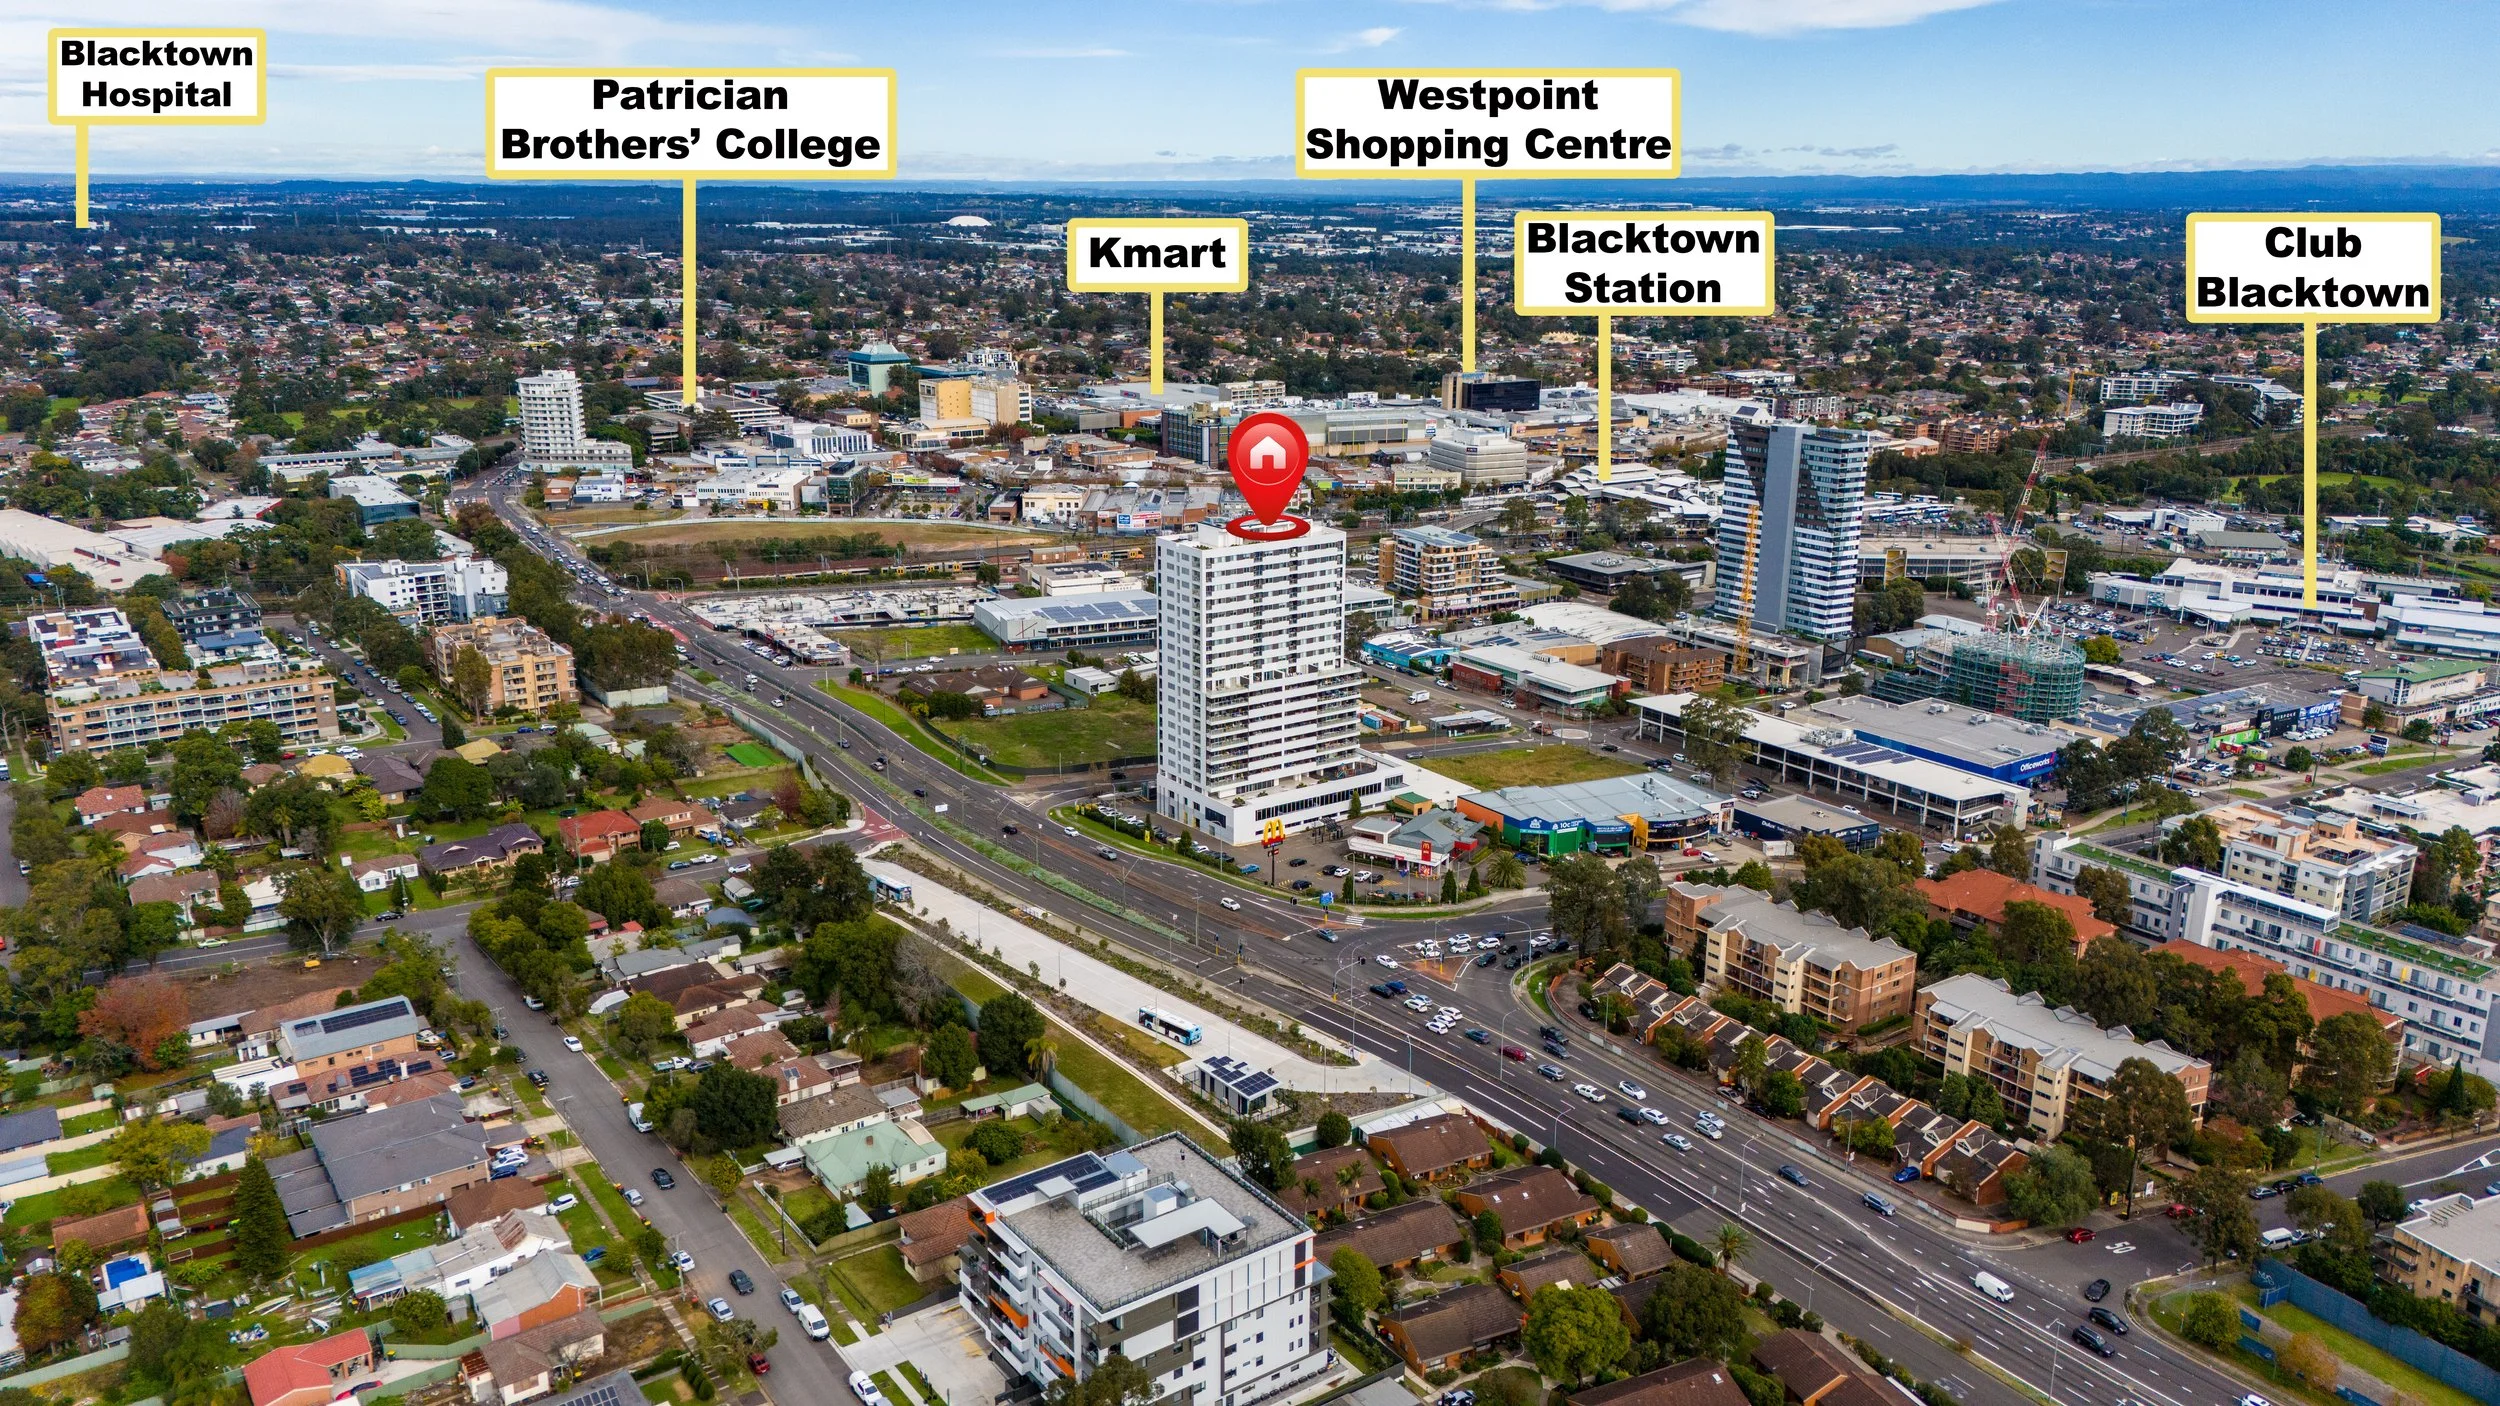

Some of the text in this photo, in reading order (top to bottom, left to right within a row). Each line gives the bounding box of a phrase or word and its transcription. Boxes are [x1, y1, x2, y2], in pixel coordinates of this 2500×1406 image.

[2274, 711, 2297, 721] BESPOKE
[2020, 757, 2050, 772] Officeworks
[1761, 820, 1775, 829] Dulux
[2105, 1241, 2137, 1254] 50
